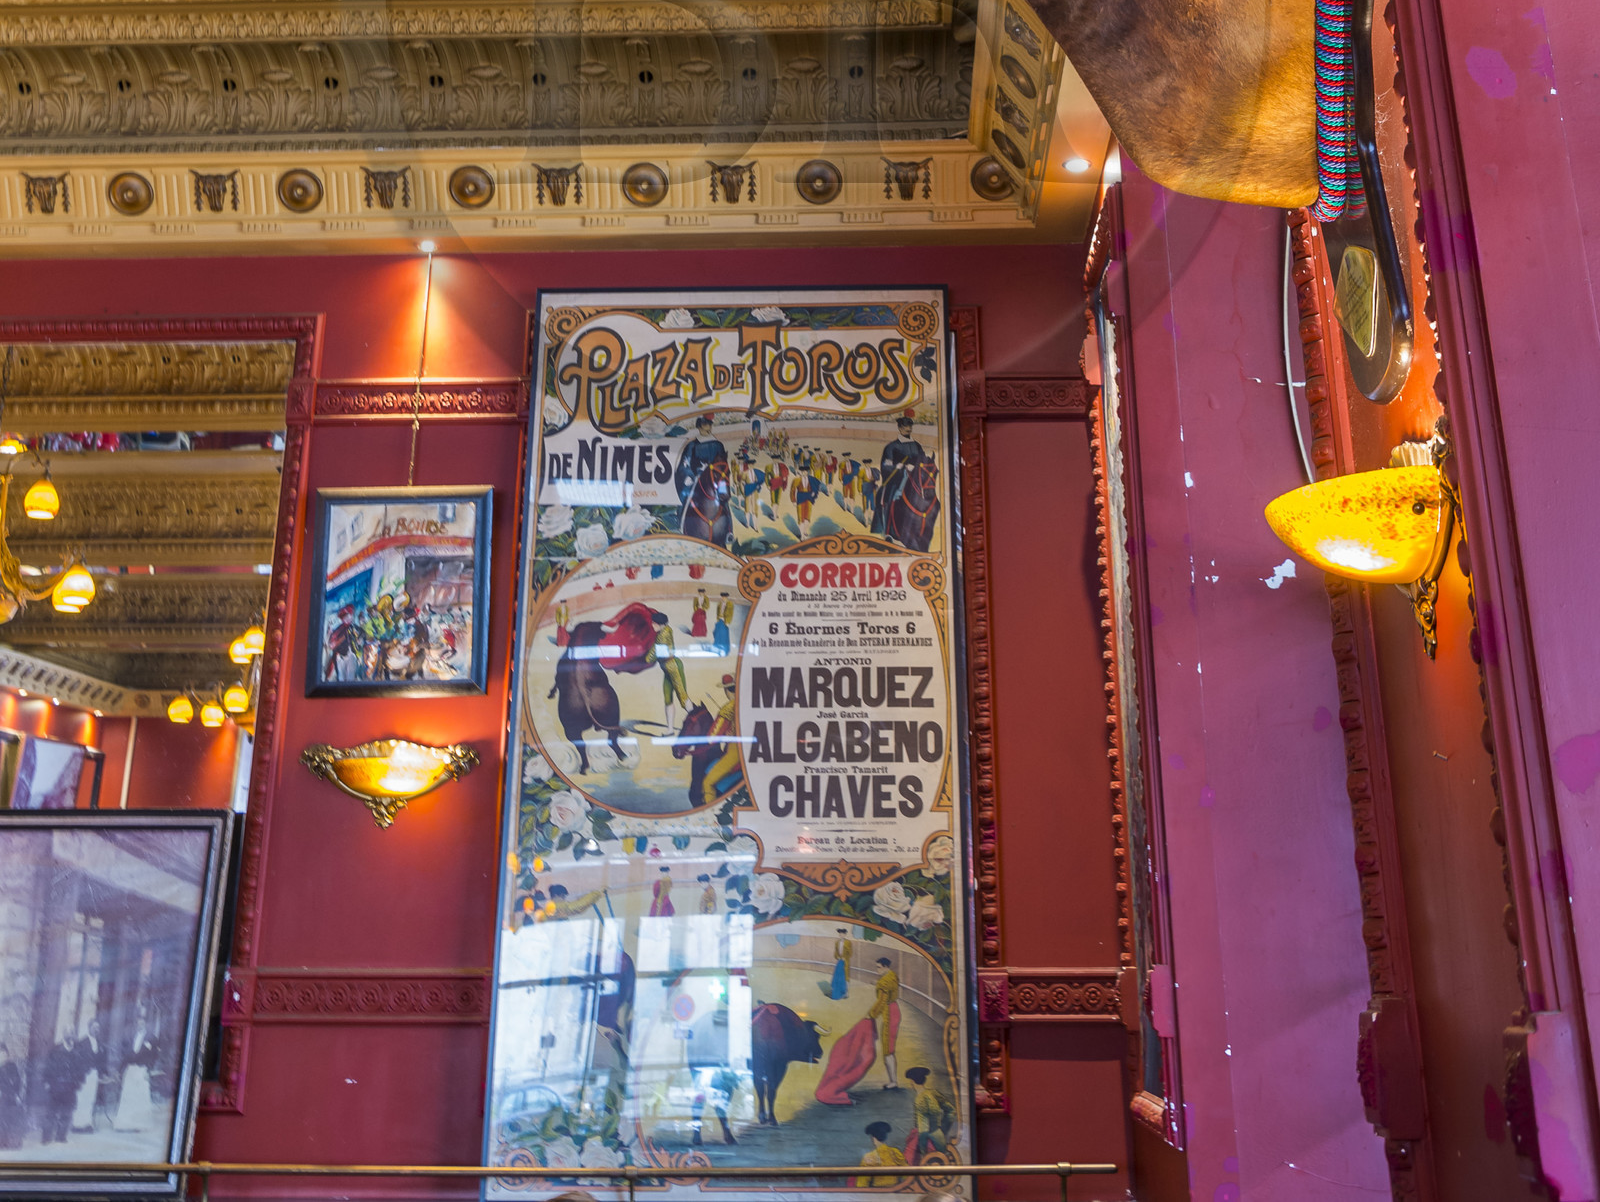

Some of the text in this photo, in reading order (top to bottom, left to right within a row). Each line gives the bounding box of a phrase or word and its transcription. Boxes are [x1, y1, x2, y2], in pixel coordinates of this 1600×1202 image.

[558, 320, 910, 436] PLAZA DE TOROS
[548, 437, 673, 485] DE NIMES
[780, 562, 903, 588] CORRIDA
[777, 589, 907, 602] du Dimanche 25 Avril 1926
[768, 622, 779, 635] 6
[857, 621, 900, 635] Toros
[906, 621, 916, 634] 6
[814, 658, 872, 666] ANTONIO
[751, 666, 935, 708] MARQUEZ
[817, 710, 837, 718] José
[748, 720, 943, 763] ALGABENO
[803, 766, 889, 774] Francisco Tamarit
[769, 775, 923, 818] CHAVES
[834, 836, 845, 844] de
[850, 836, 888, 844] Location
